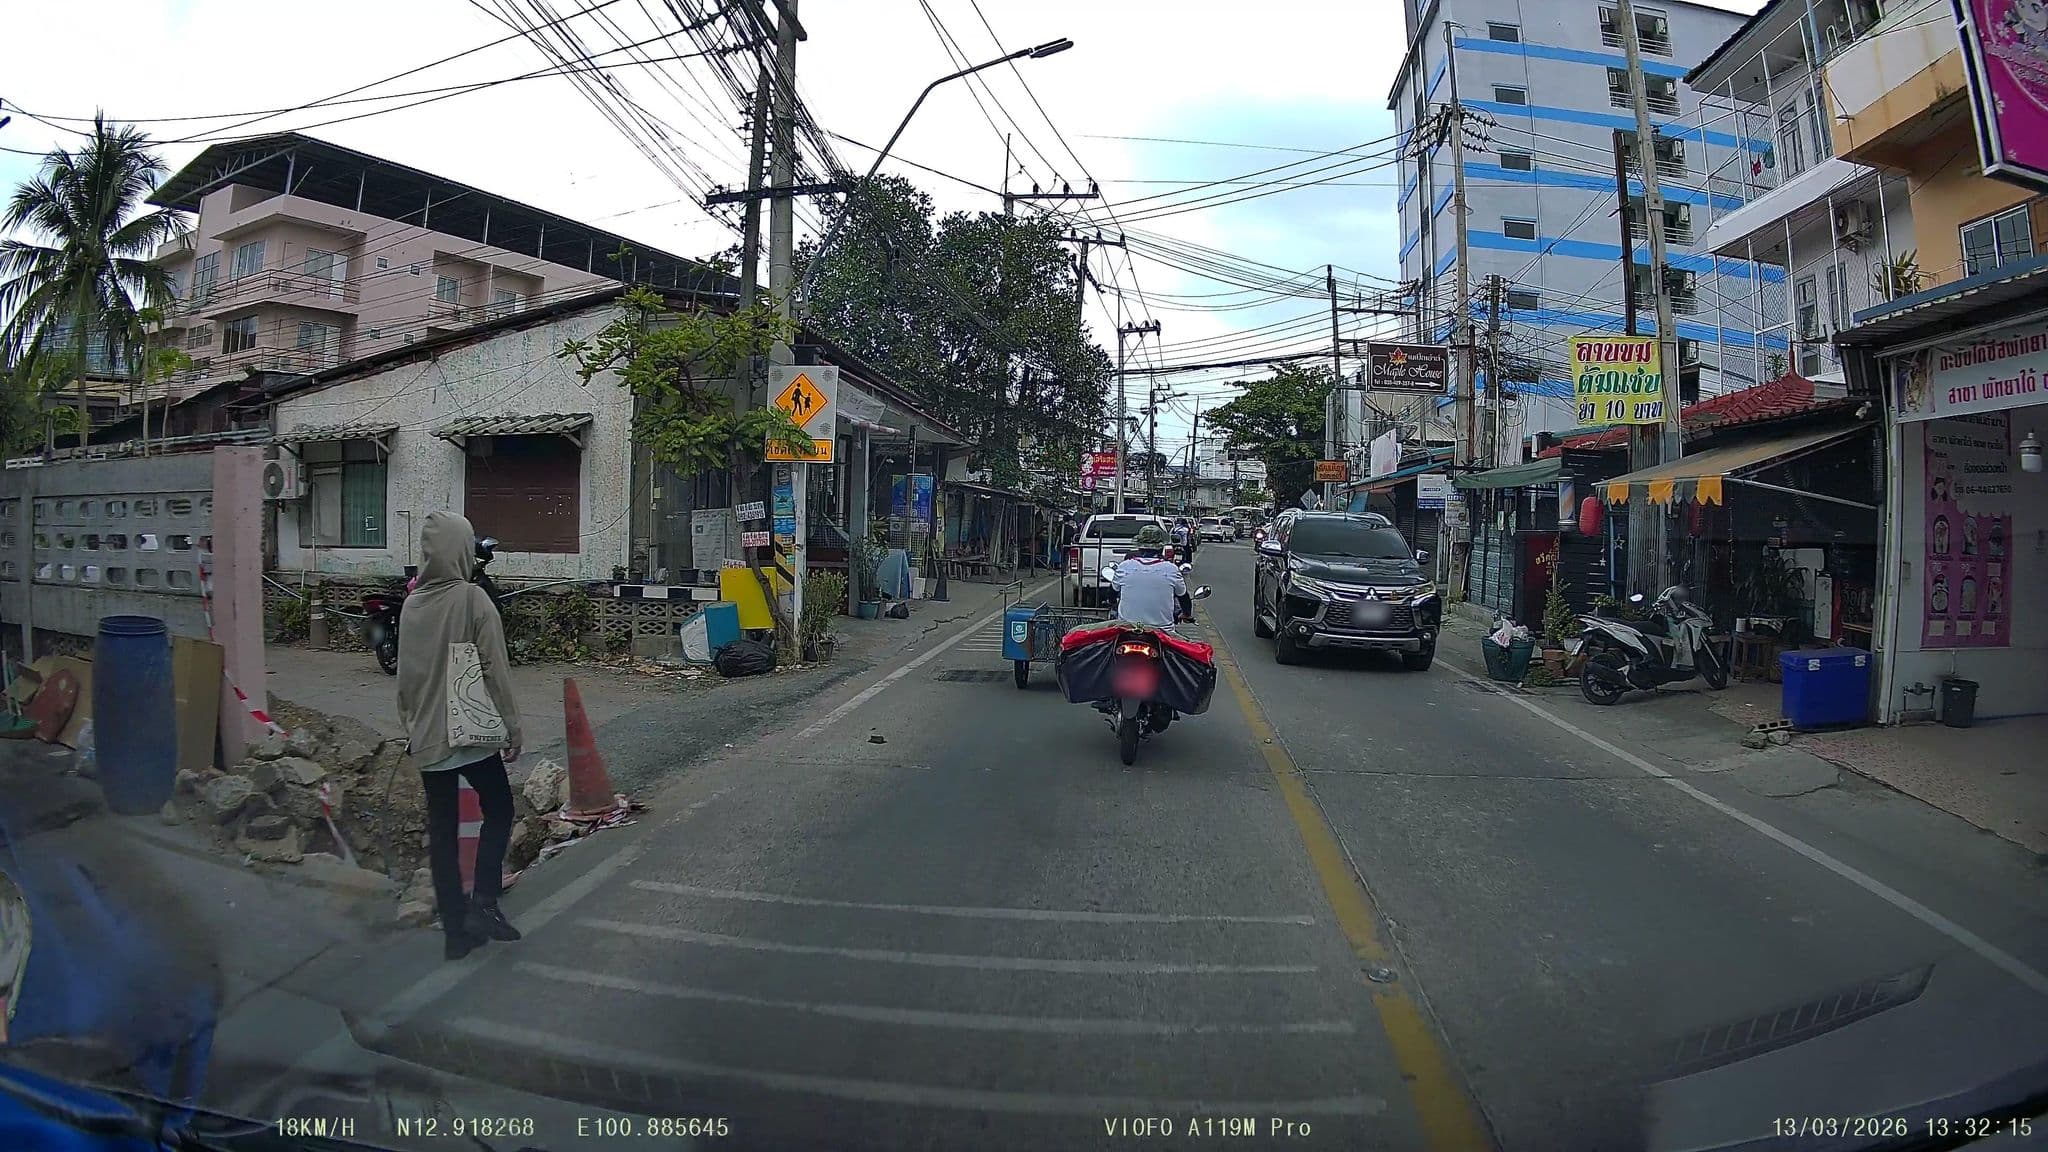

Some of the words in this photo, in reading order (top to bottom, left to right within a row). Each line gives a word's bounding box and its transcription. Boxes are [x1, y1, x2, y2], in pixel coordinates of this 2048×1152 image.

[1576, 341, 1653, 363] ลาบขม
[1373, 362, 1406, 380] Maple
[1408, 363, 1443, 379] House
[1948, 385, 1977, 404] สาขา
[1982, 367, 2036, 399] พัทยาใต้
[1578, 396, 1596, 421] ยำ
[1606, 400, 1625, 420] 10
[1634, 401, 1663, 420] บาท
